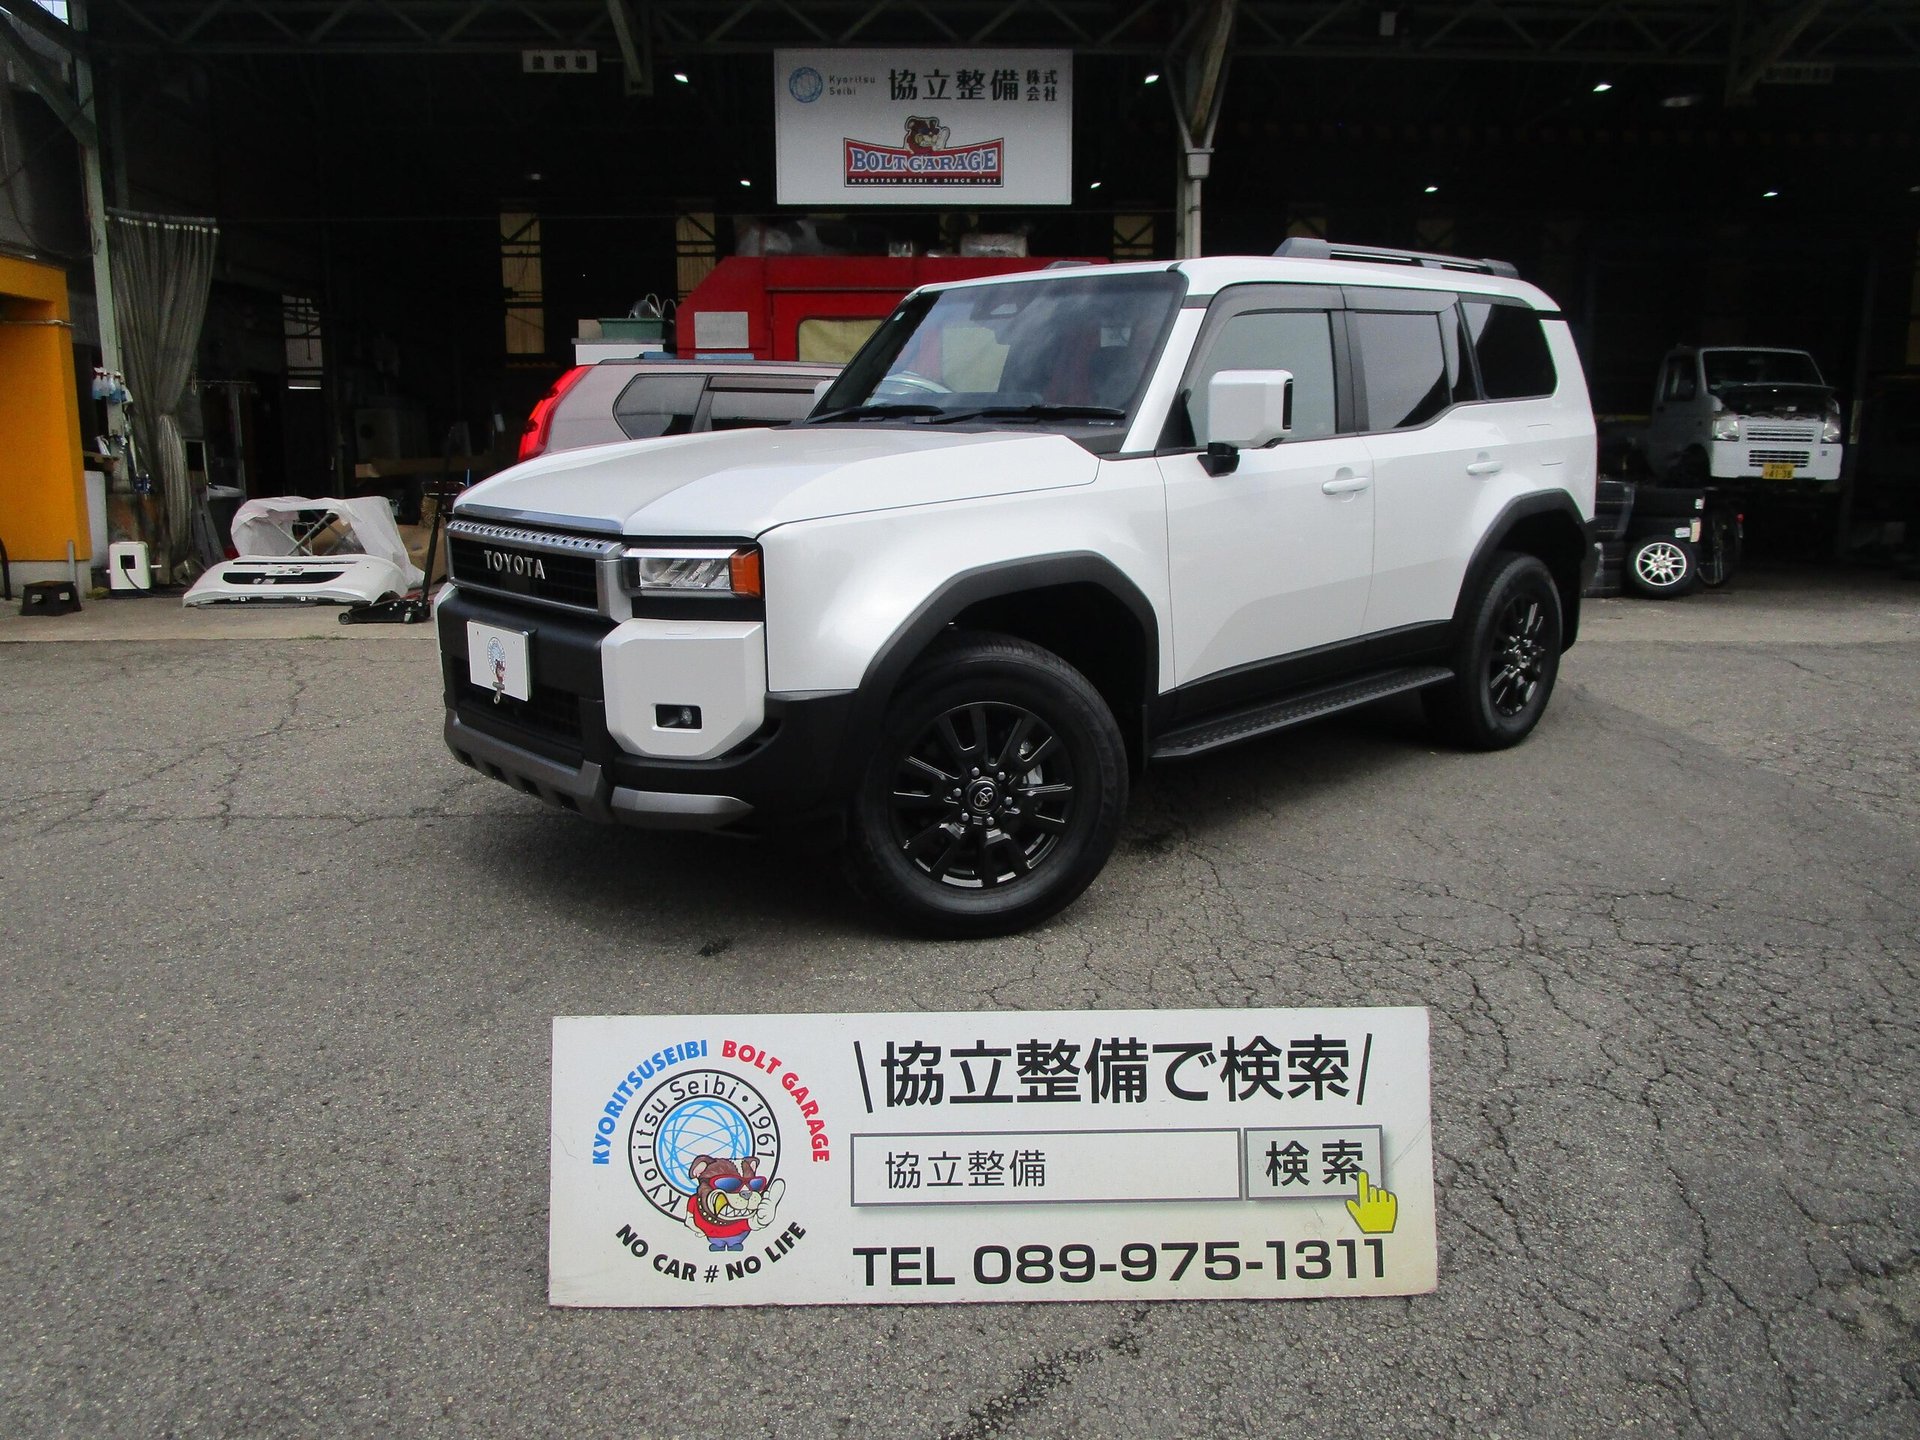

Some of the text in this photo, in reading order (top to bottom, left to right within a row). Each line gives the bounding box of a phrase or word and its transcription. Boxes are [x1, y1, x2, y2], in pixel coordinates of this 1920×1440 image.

[829, 74, 876, 86] Kyoritsu
[829, 86, 857, 96] Seibi
[888, 68, 1020, 101] 協立整備
[851, 148, 998, 172] BOLT GARAGE
[484, 550, 546, 580] TOYOTA
[592, 1039, 708, 1165] KYORITSUSEIBI
[721, 1039, 830, 1163] BOLT GARAGE
[633, 1096, 682, 1213] Kyoritsu
[885, 1150, 1047, 1189] 協立整備
[1265, 1138, 1365, 1188] 検索
[615, 1223, 649, 1258] NO
[652, 1253, 698, 1282] CAR
[725, 1255, 762, 1281] NO
[764, 1221, 807, 1263] LIFE
[853, 1238, 1386, 1286] TEL 089-975-1311
